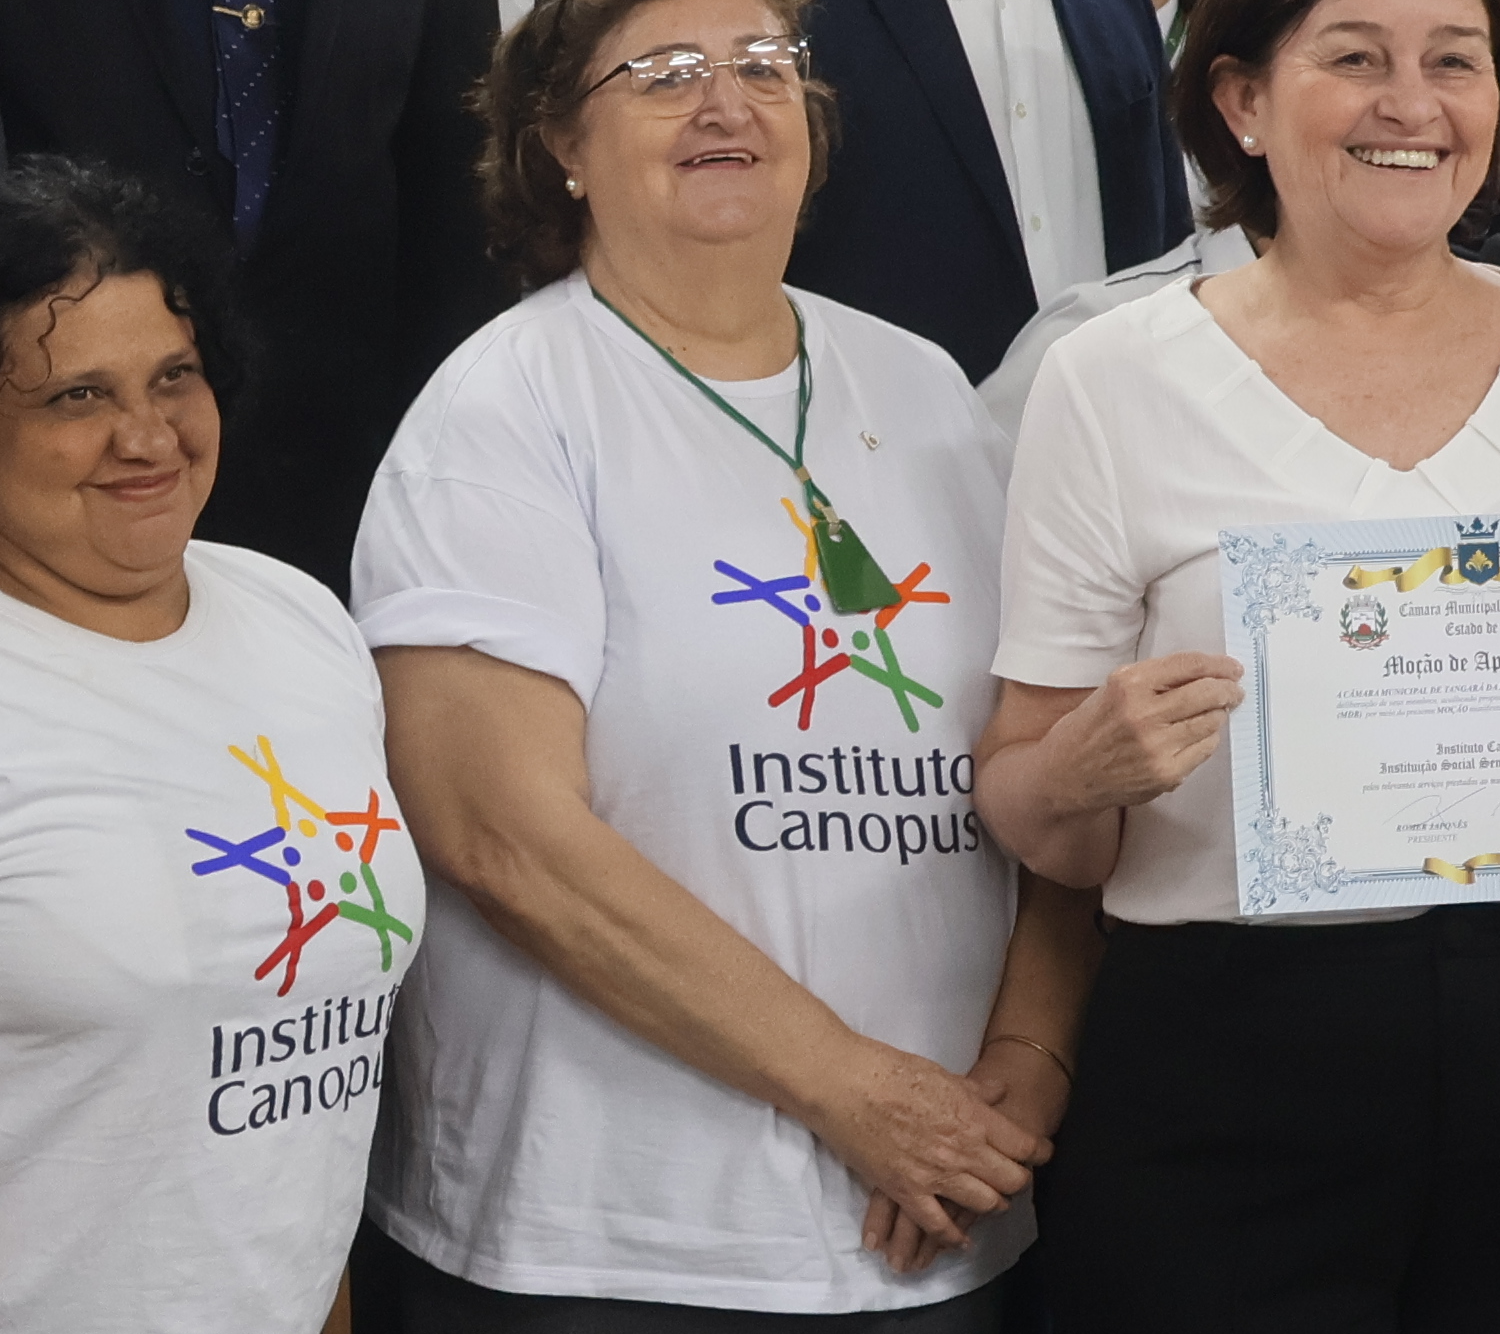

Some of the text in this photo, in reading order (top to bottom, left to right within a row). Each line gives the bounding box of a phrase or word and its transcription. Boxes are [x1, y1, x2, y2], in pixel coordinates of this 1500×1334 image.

[1399, 601, 1441, 617] Câmara
[1445, 599, 1500, 616] Municipal
[1445, 620, 1483, 637] Estado
[1486, 620, 1498, 635] de
[1382, 653, 1443, 679] Moção
[1449, 651, 1468, 672] de
[1436, 742, 1484, 755] Instituto
[728, 743, 974, 797] Instituto
[1379, 760, 1438, 775] Instituição
[1440, 756, 1476, 771] Social
[735, 800, 979, 866] Canopus
